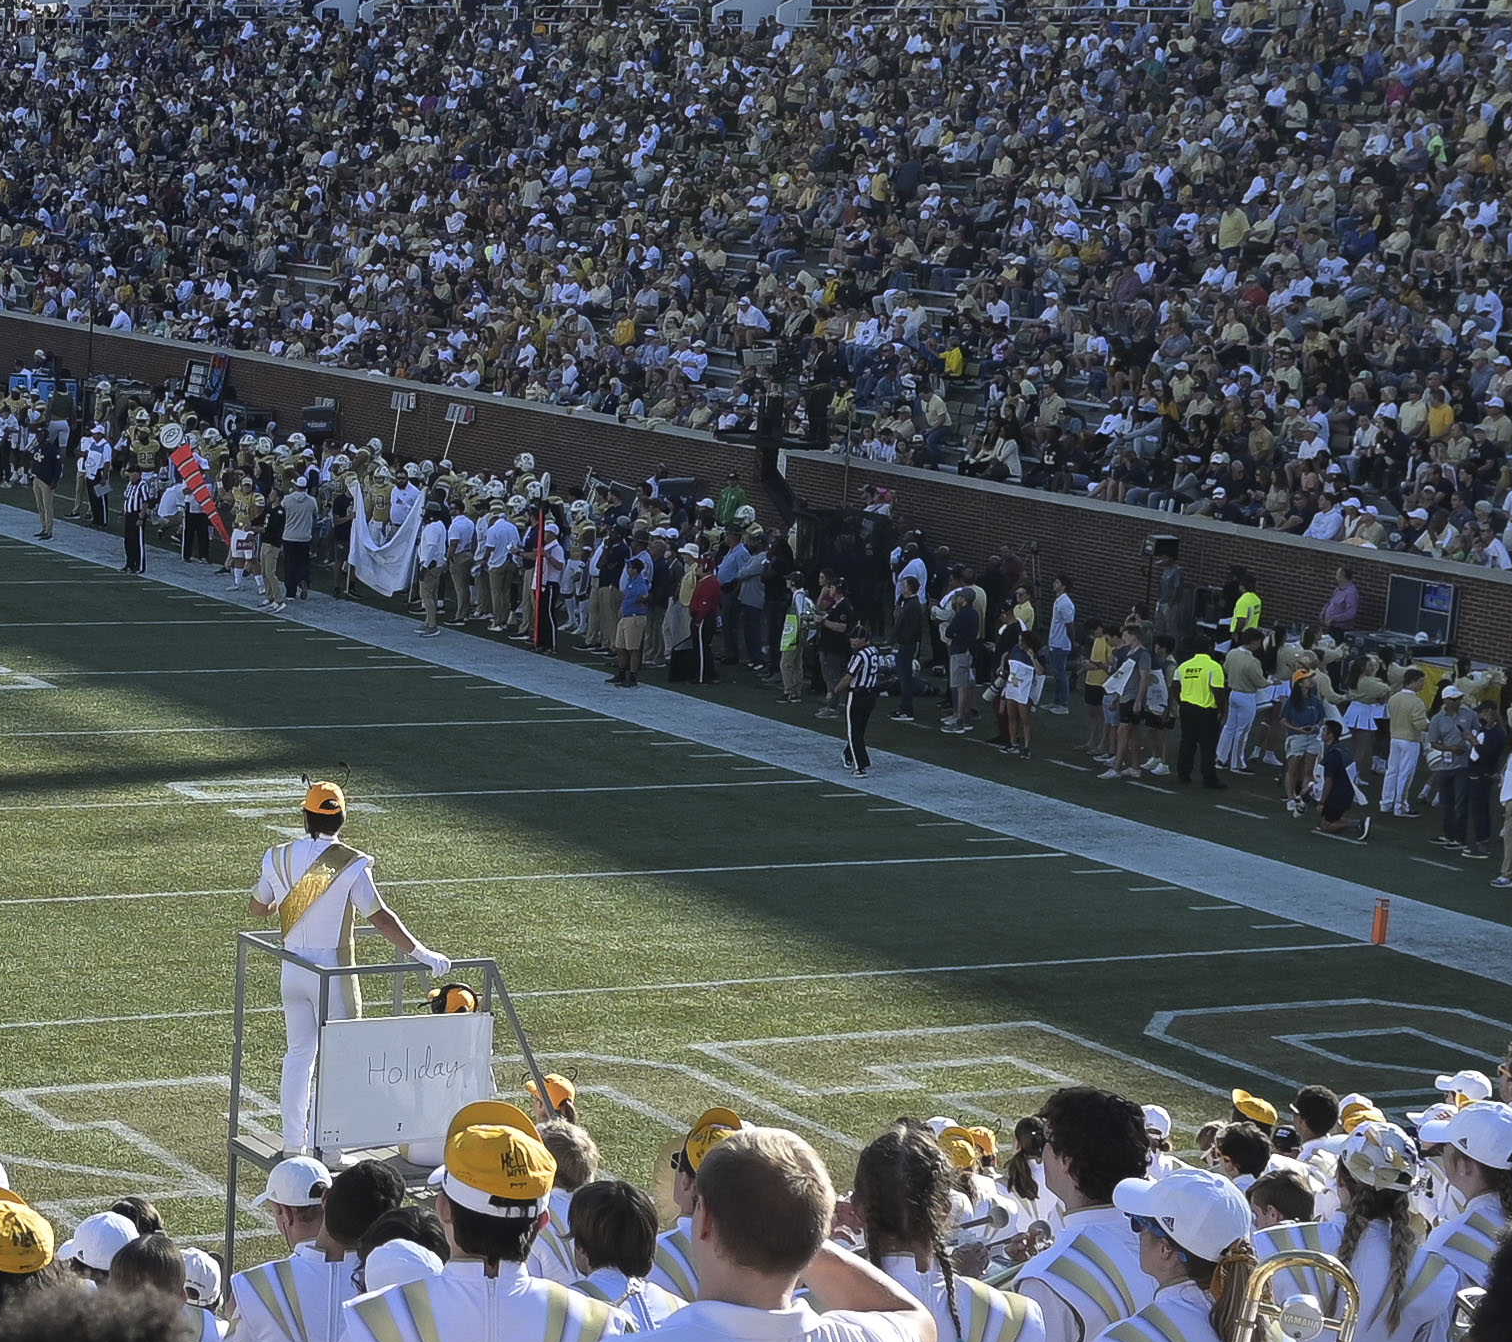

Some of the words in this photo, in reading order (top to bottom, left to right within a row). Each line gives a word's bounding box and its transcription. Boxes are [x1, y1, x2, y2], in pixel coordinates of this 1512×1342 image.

[870, 654, 879, 673] S
[367, 1044, 465, 1088] Holiday
[1283, 1312, 1320, 1331] YAMAHA
